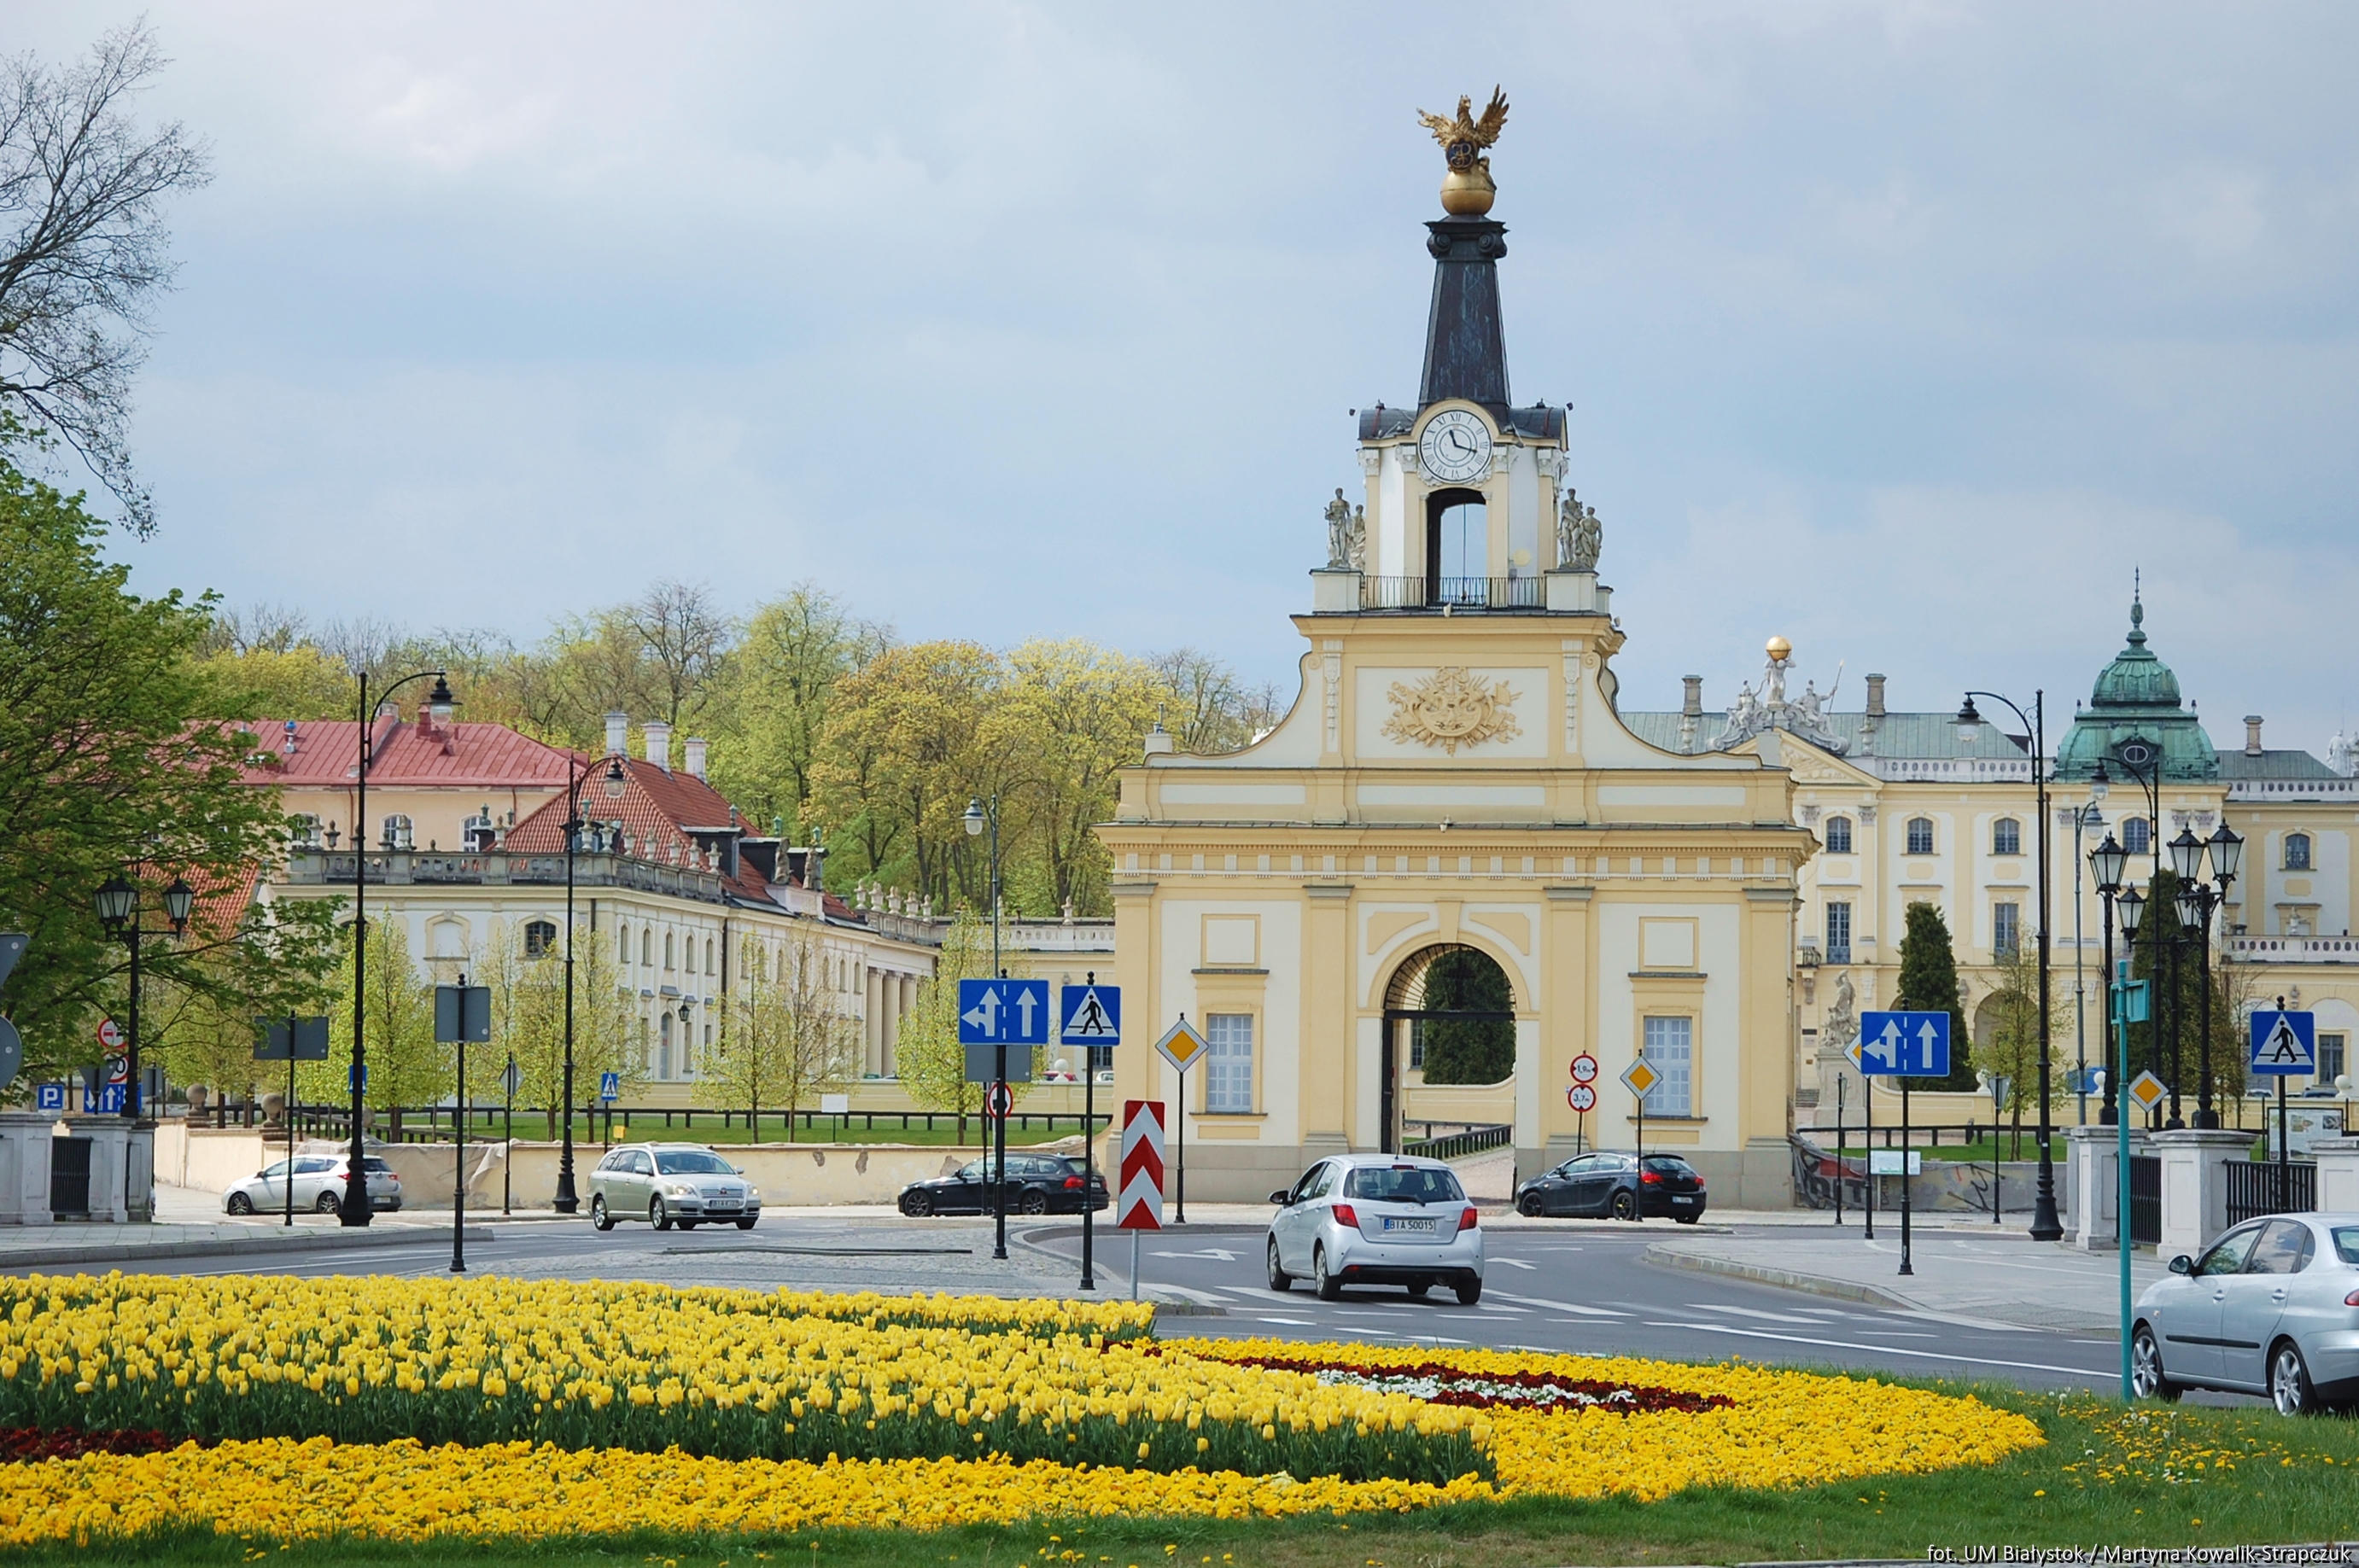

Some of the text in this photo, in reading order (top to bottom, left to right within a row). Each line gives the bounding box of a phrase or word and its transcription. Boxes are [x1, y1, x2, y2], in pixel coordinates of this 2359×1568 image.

[44, 1088, 58, 1106] P
[1390, 1220, 1405, 1230] BIA
[1409, 1220, 1434, 1230] 50015
